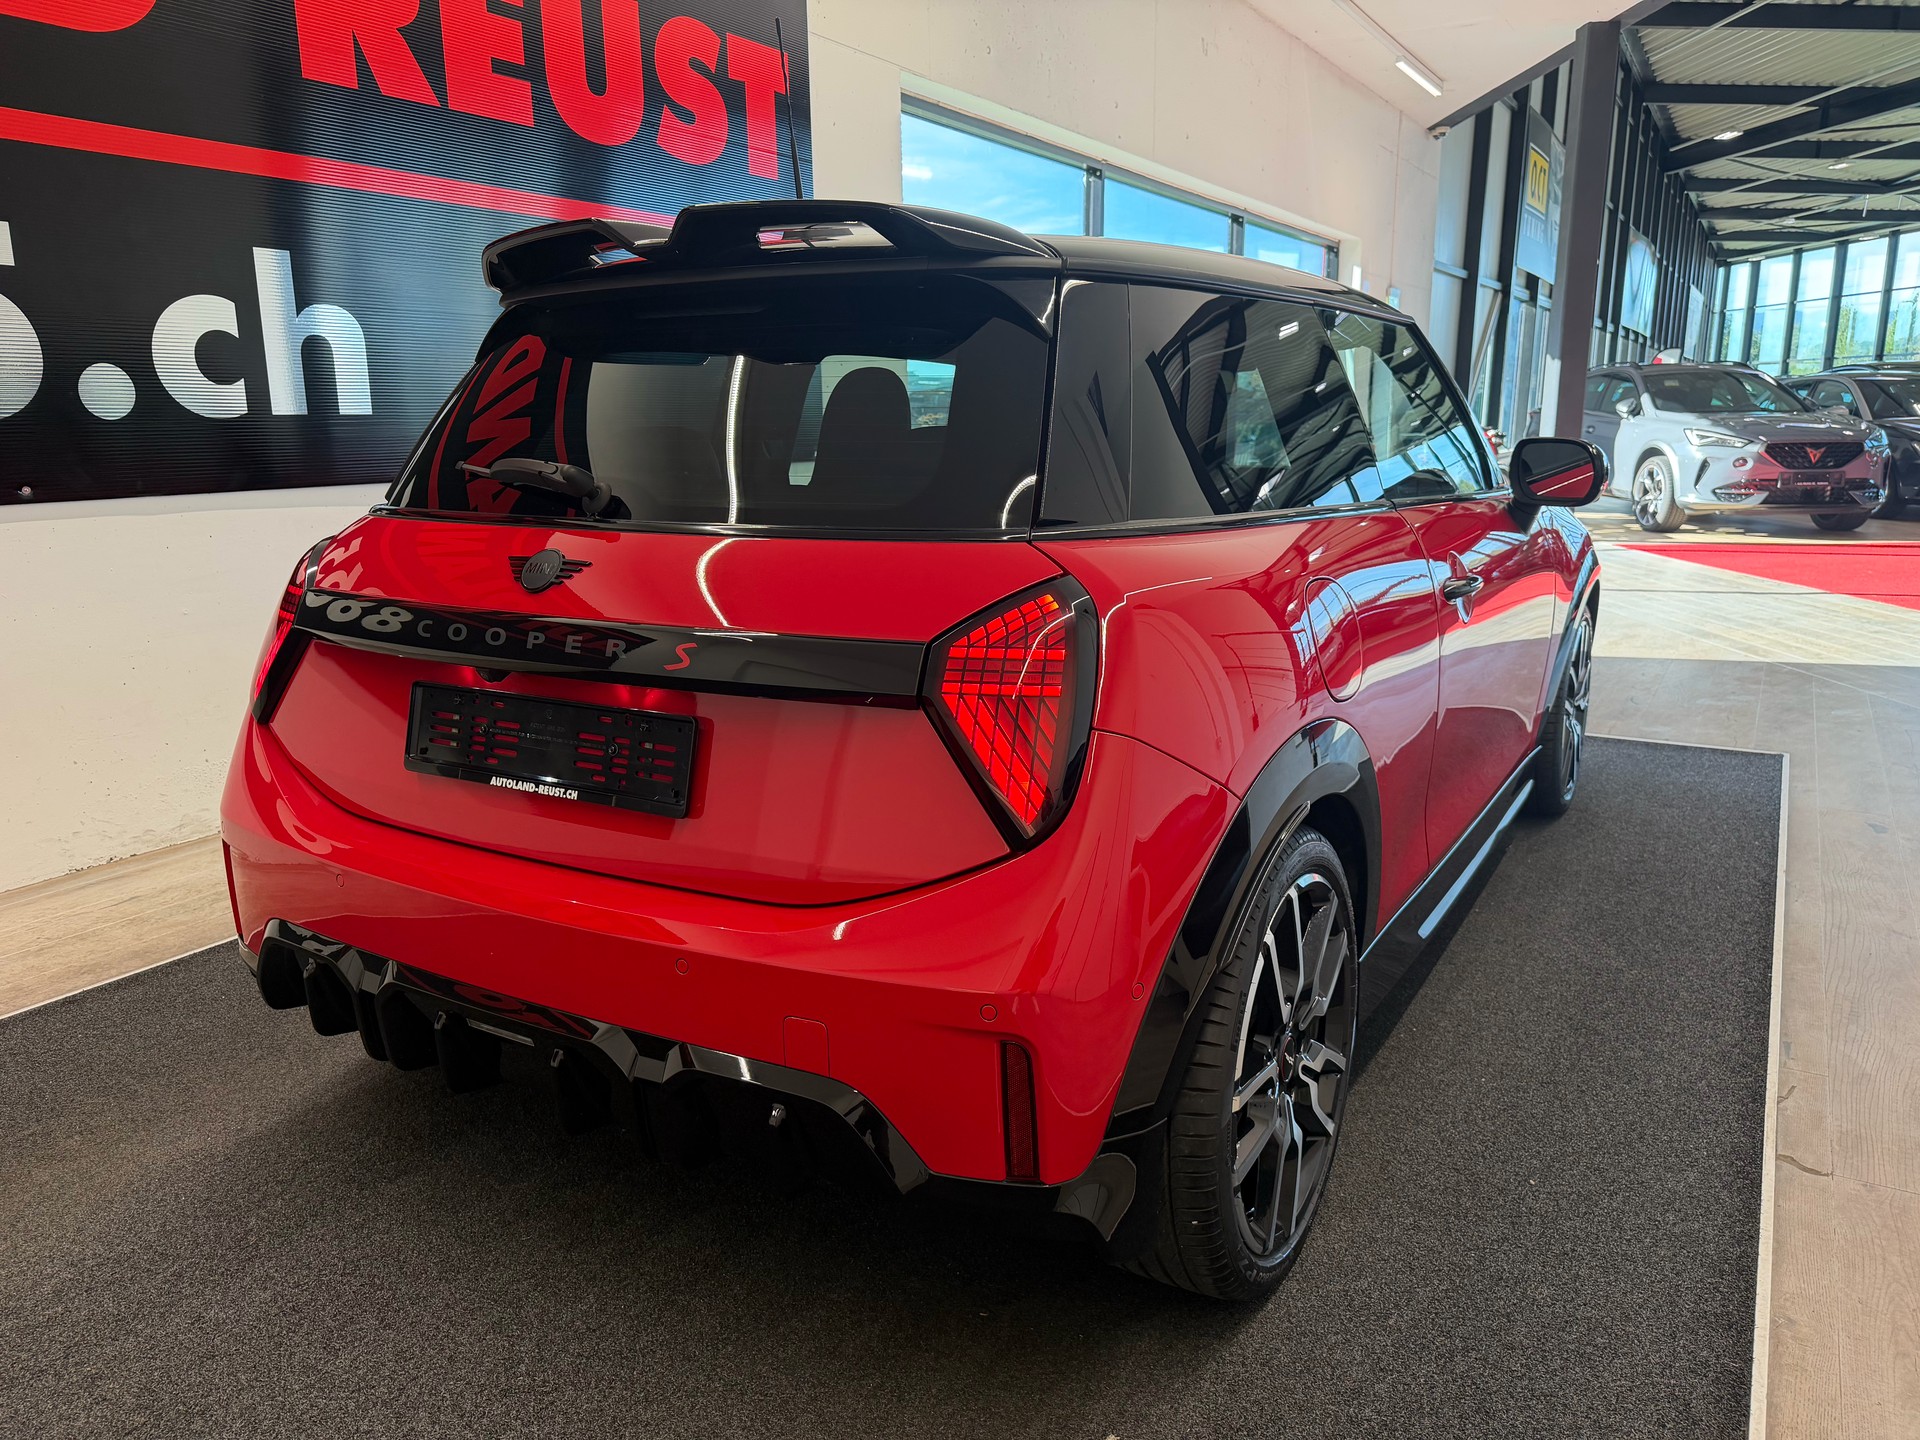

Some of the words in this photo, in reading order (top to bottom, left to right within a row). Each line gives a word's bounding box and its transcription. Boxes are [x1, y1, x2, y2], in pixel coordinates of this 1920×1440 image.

[416, 619, 628, 659] COOPER
[663, 642, 698, 671] S
[490, 775, 579, 801] AUTOLAND-REUST.CH
